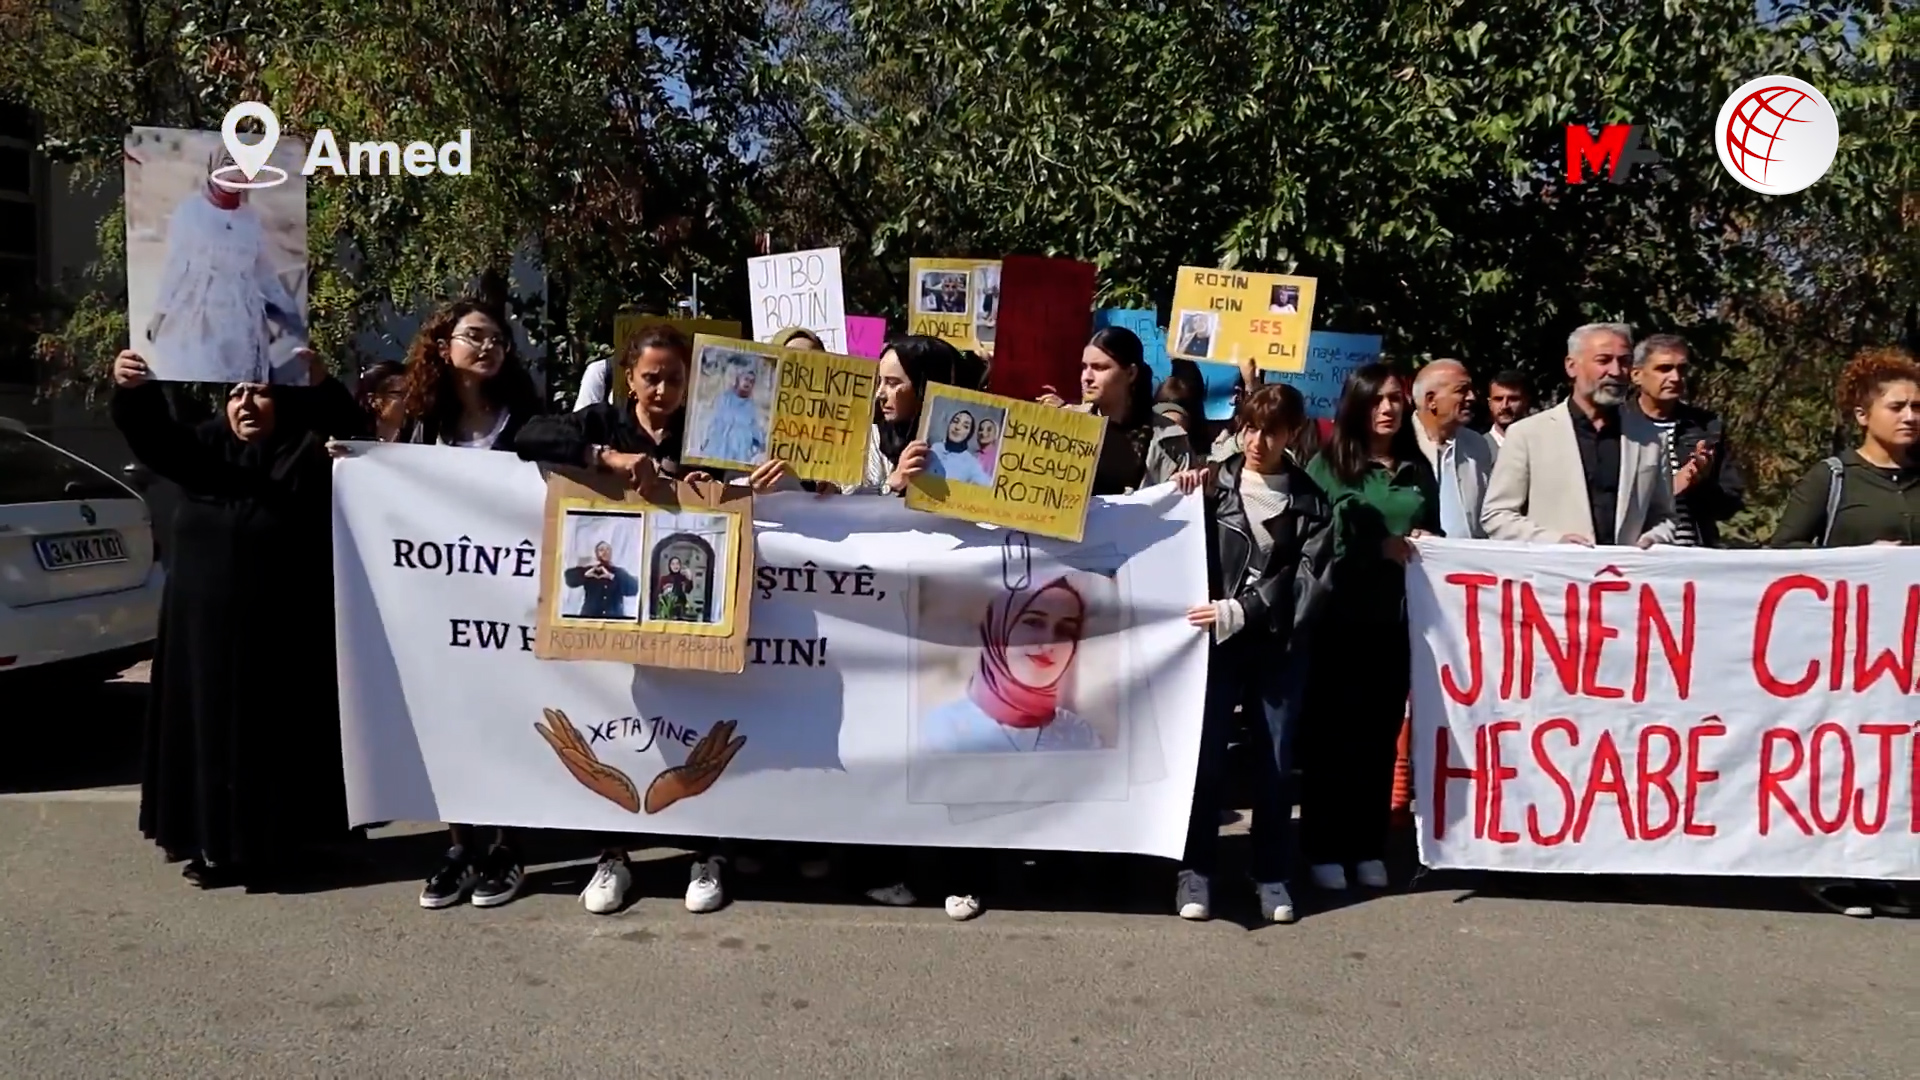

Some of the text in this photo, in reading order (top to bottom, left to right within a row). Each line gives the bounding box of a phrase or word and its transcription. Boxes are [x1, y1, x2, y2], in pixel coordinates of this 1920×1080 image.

[757, 254, 825, 290] JI BO
[761, 287, 828, 330] ROJÎN
[915, 319, 971, 339] ADALET
[1249, 318, 1282, 336] SES
[772, 419, 854, 445] ADALET
[1000, 452, 1087, 484] OLSAYDI
[49, 542, 73, 563] 34
[757, 560, 819, 600] ŞTÎ
[823, 564, 886, 602] YÊ,
[449, 618, 511, 650] EW
[747, 637, 827, 668] TIN!
[1441, 564, 1920, 706] JINÊN CIW
[586, 716, 642, 745] XETA
[1433, 714, 1728, 847] HESABÊ
